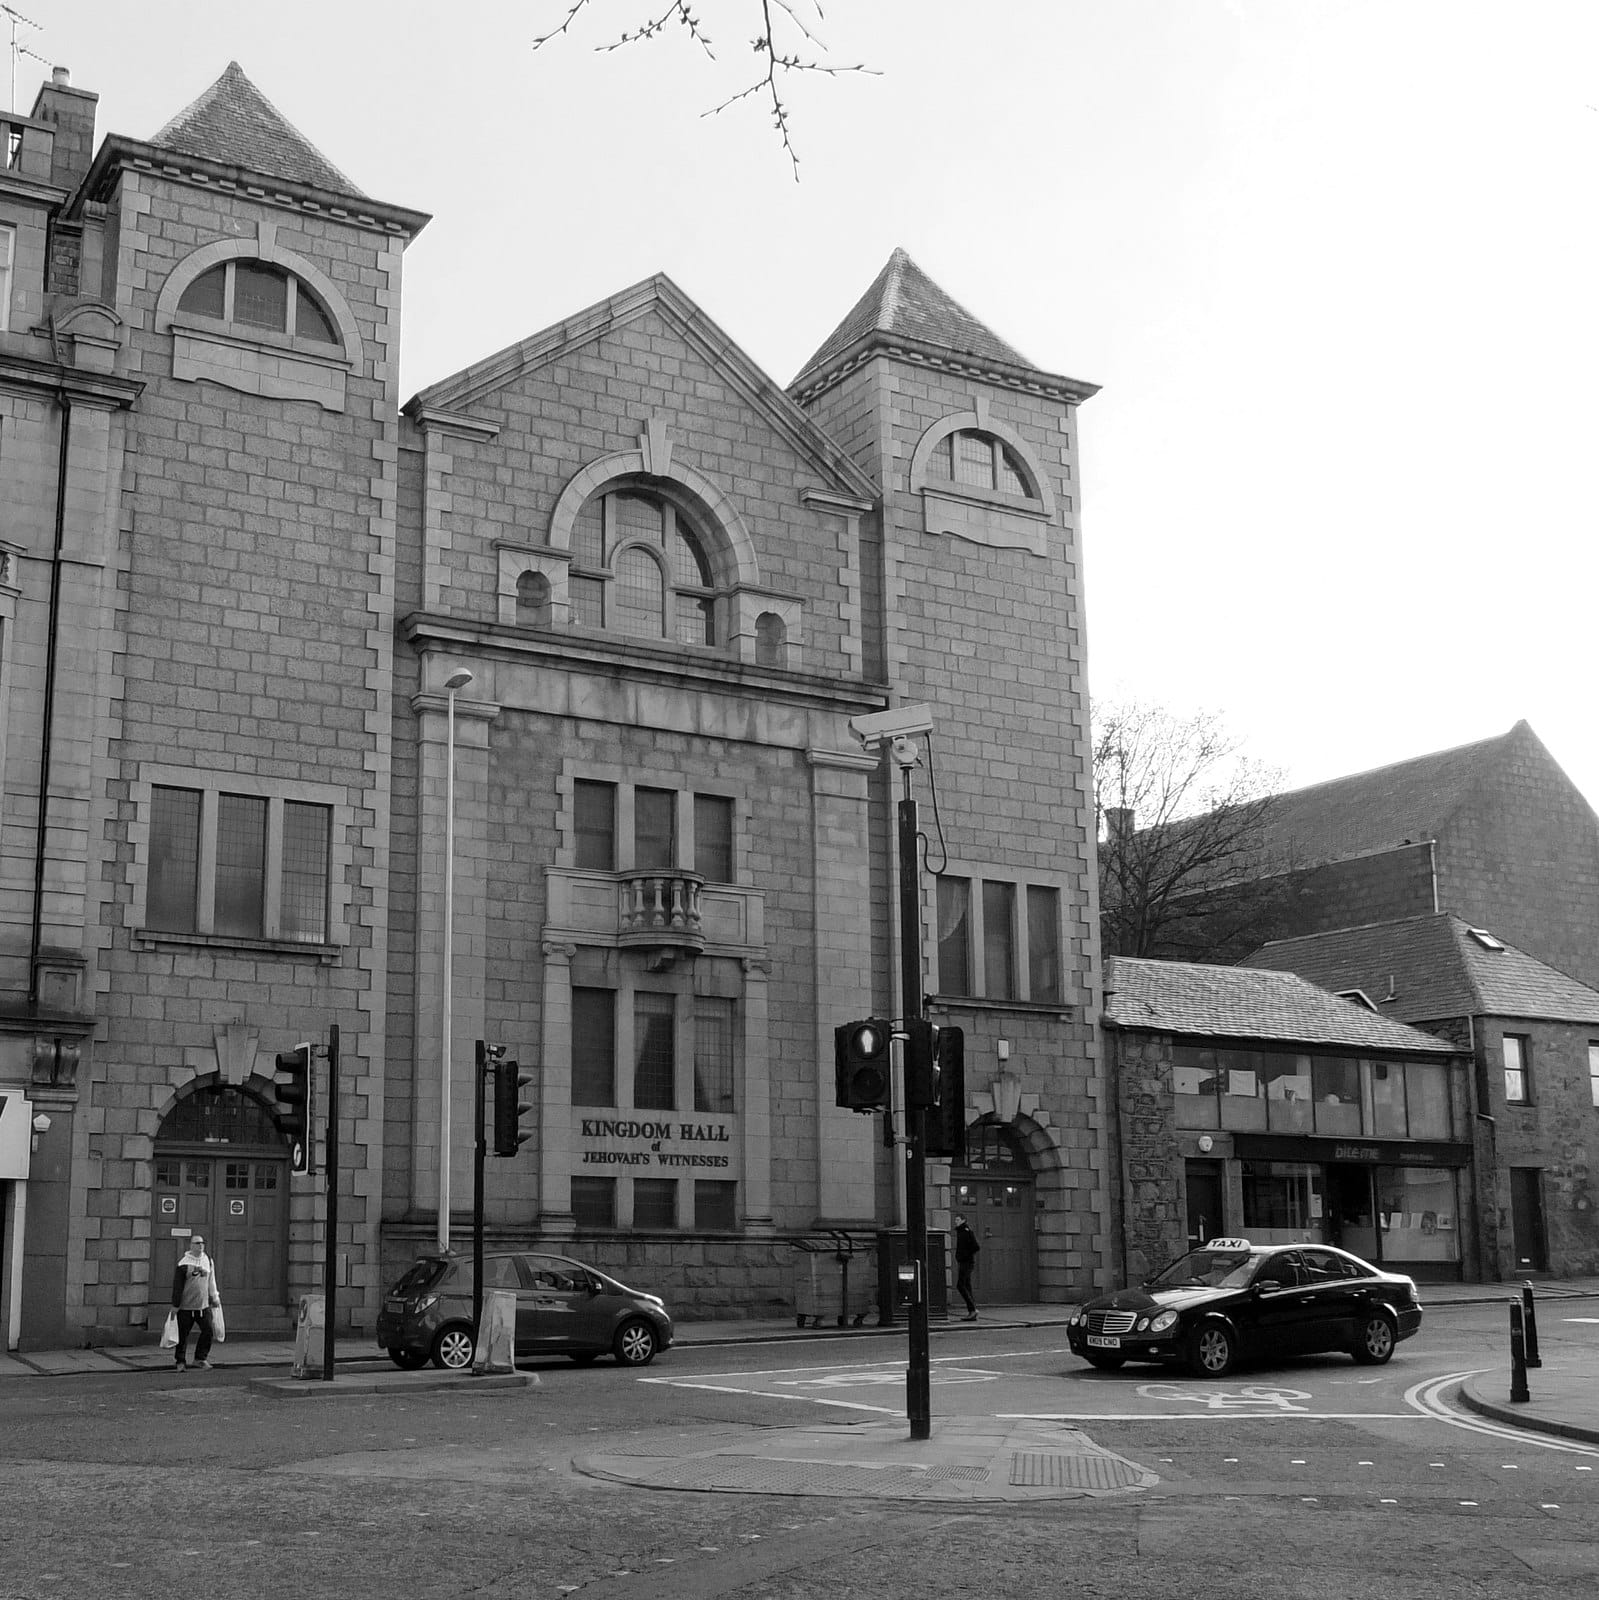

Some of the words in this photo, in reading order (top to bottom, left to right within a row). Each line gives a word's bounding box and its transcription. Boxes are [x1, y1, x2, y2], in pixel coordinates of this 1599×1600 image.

[581, 1119, 672, 1140] KINGDOM
[679, 1123, 730, 1142] HALL
[651, 1141, 662, 1152] of
[582, 1151, 650, 1165] JEHOVAH'S
[657, 1154, 729, 1167] WITNESSES
[1211, 1239, 1243, 1248] TAXI
